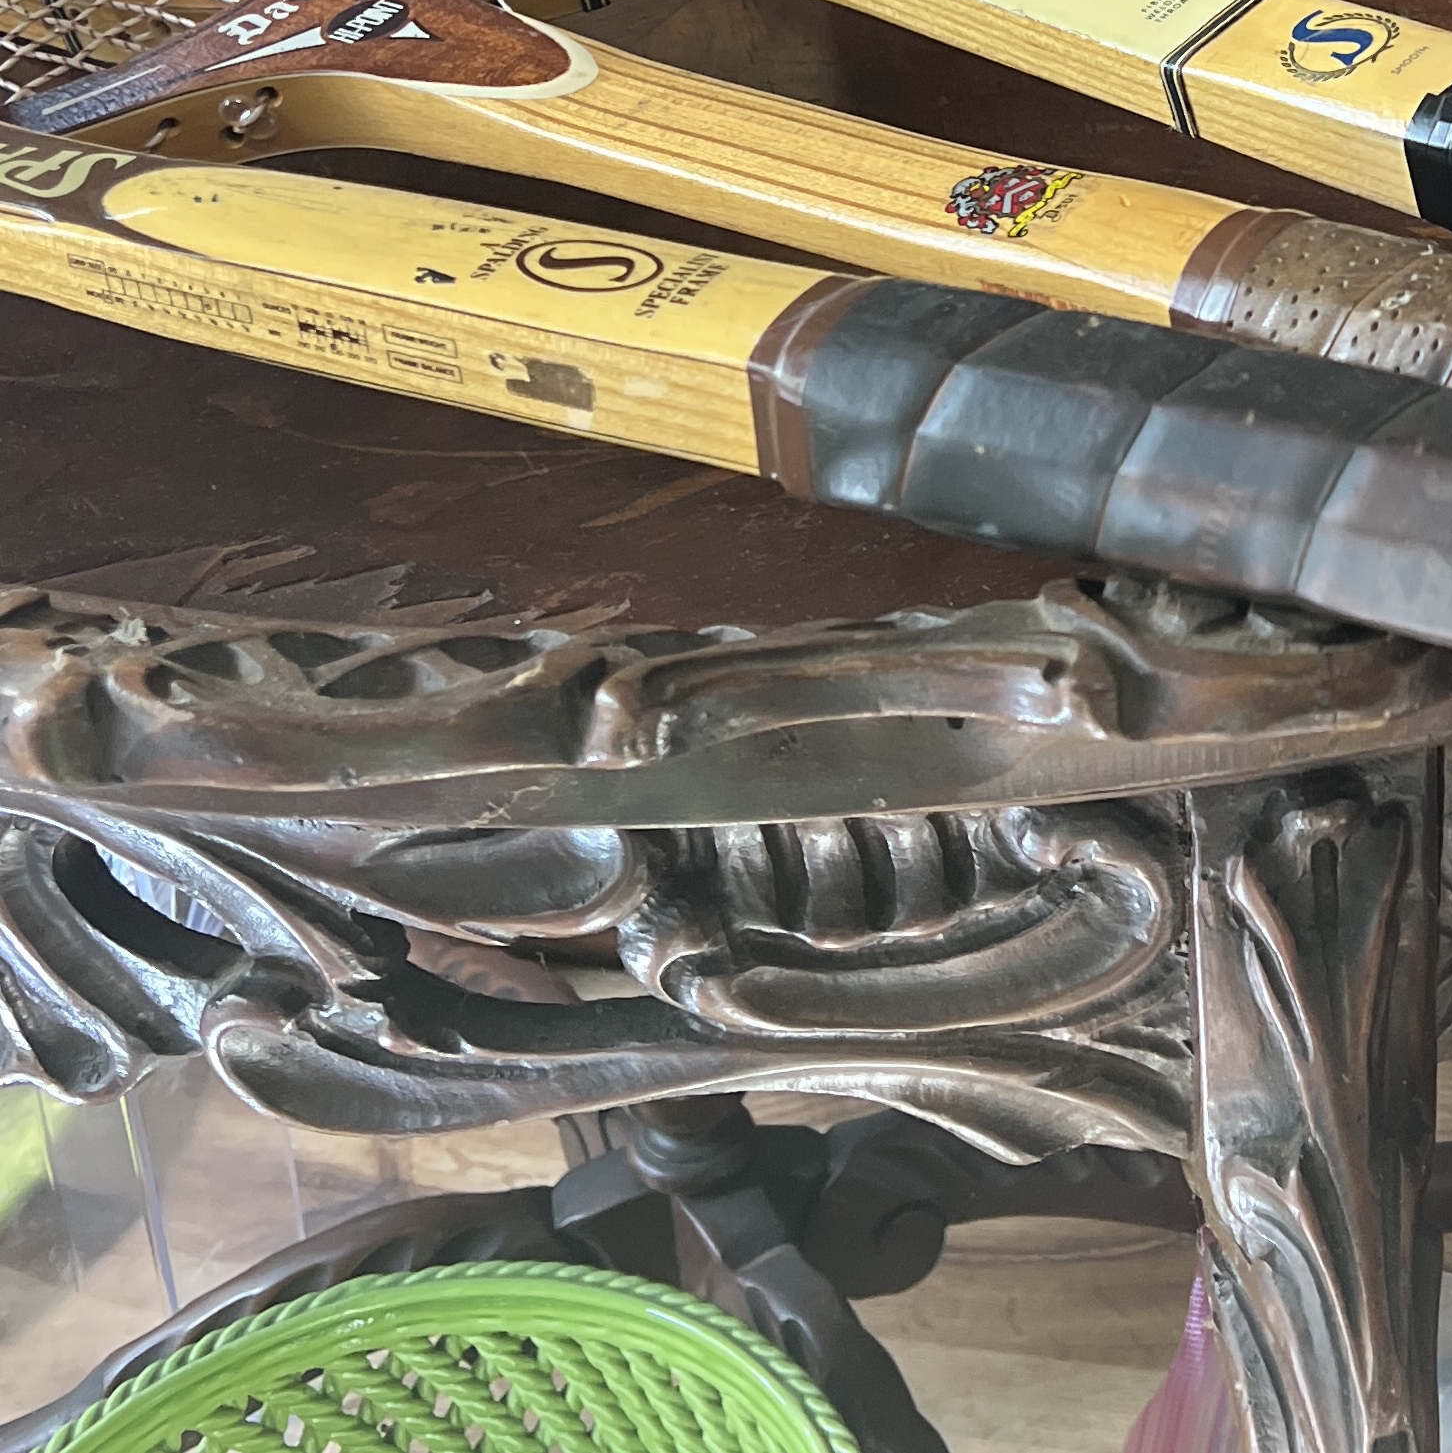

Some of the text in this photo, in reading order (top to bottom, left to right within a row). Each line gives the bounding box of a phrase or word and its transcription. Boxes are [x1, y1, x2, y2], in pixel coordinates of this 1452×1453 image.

[0, 143, 137, 199] SP
[470, 225, 549, 281] SPALDING
[634, 253, 720, 319] SPECIALIST
[669, 262, 731, 306] FRAME
